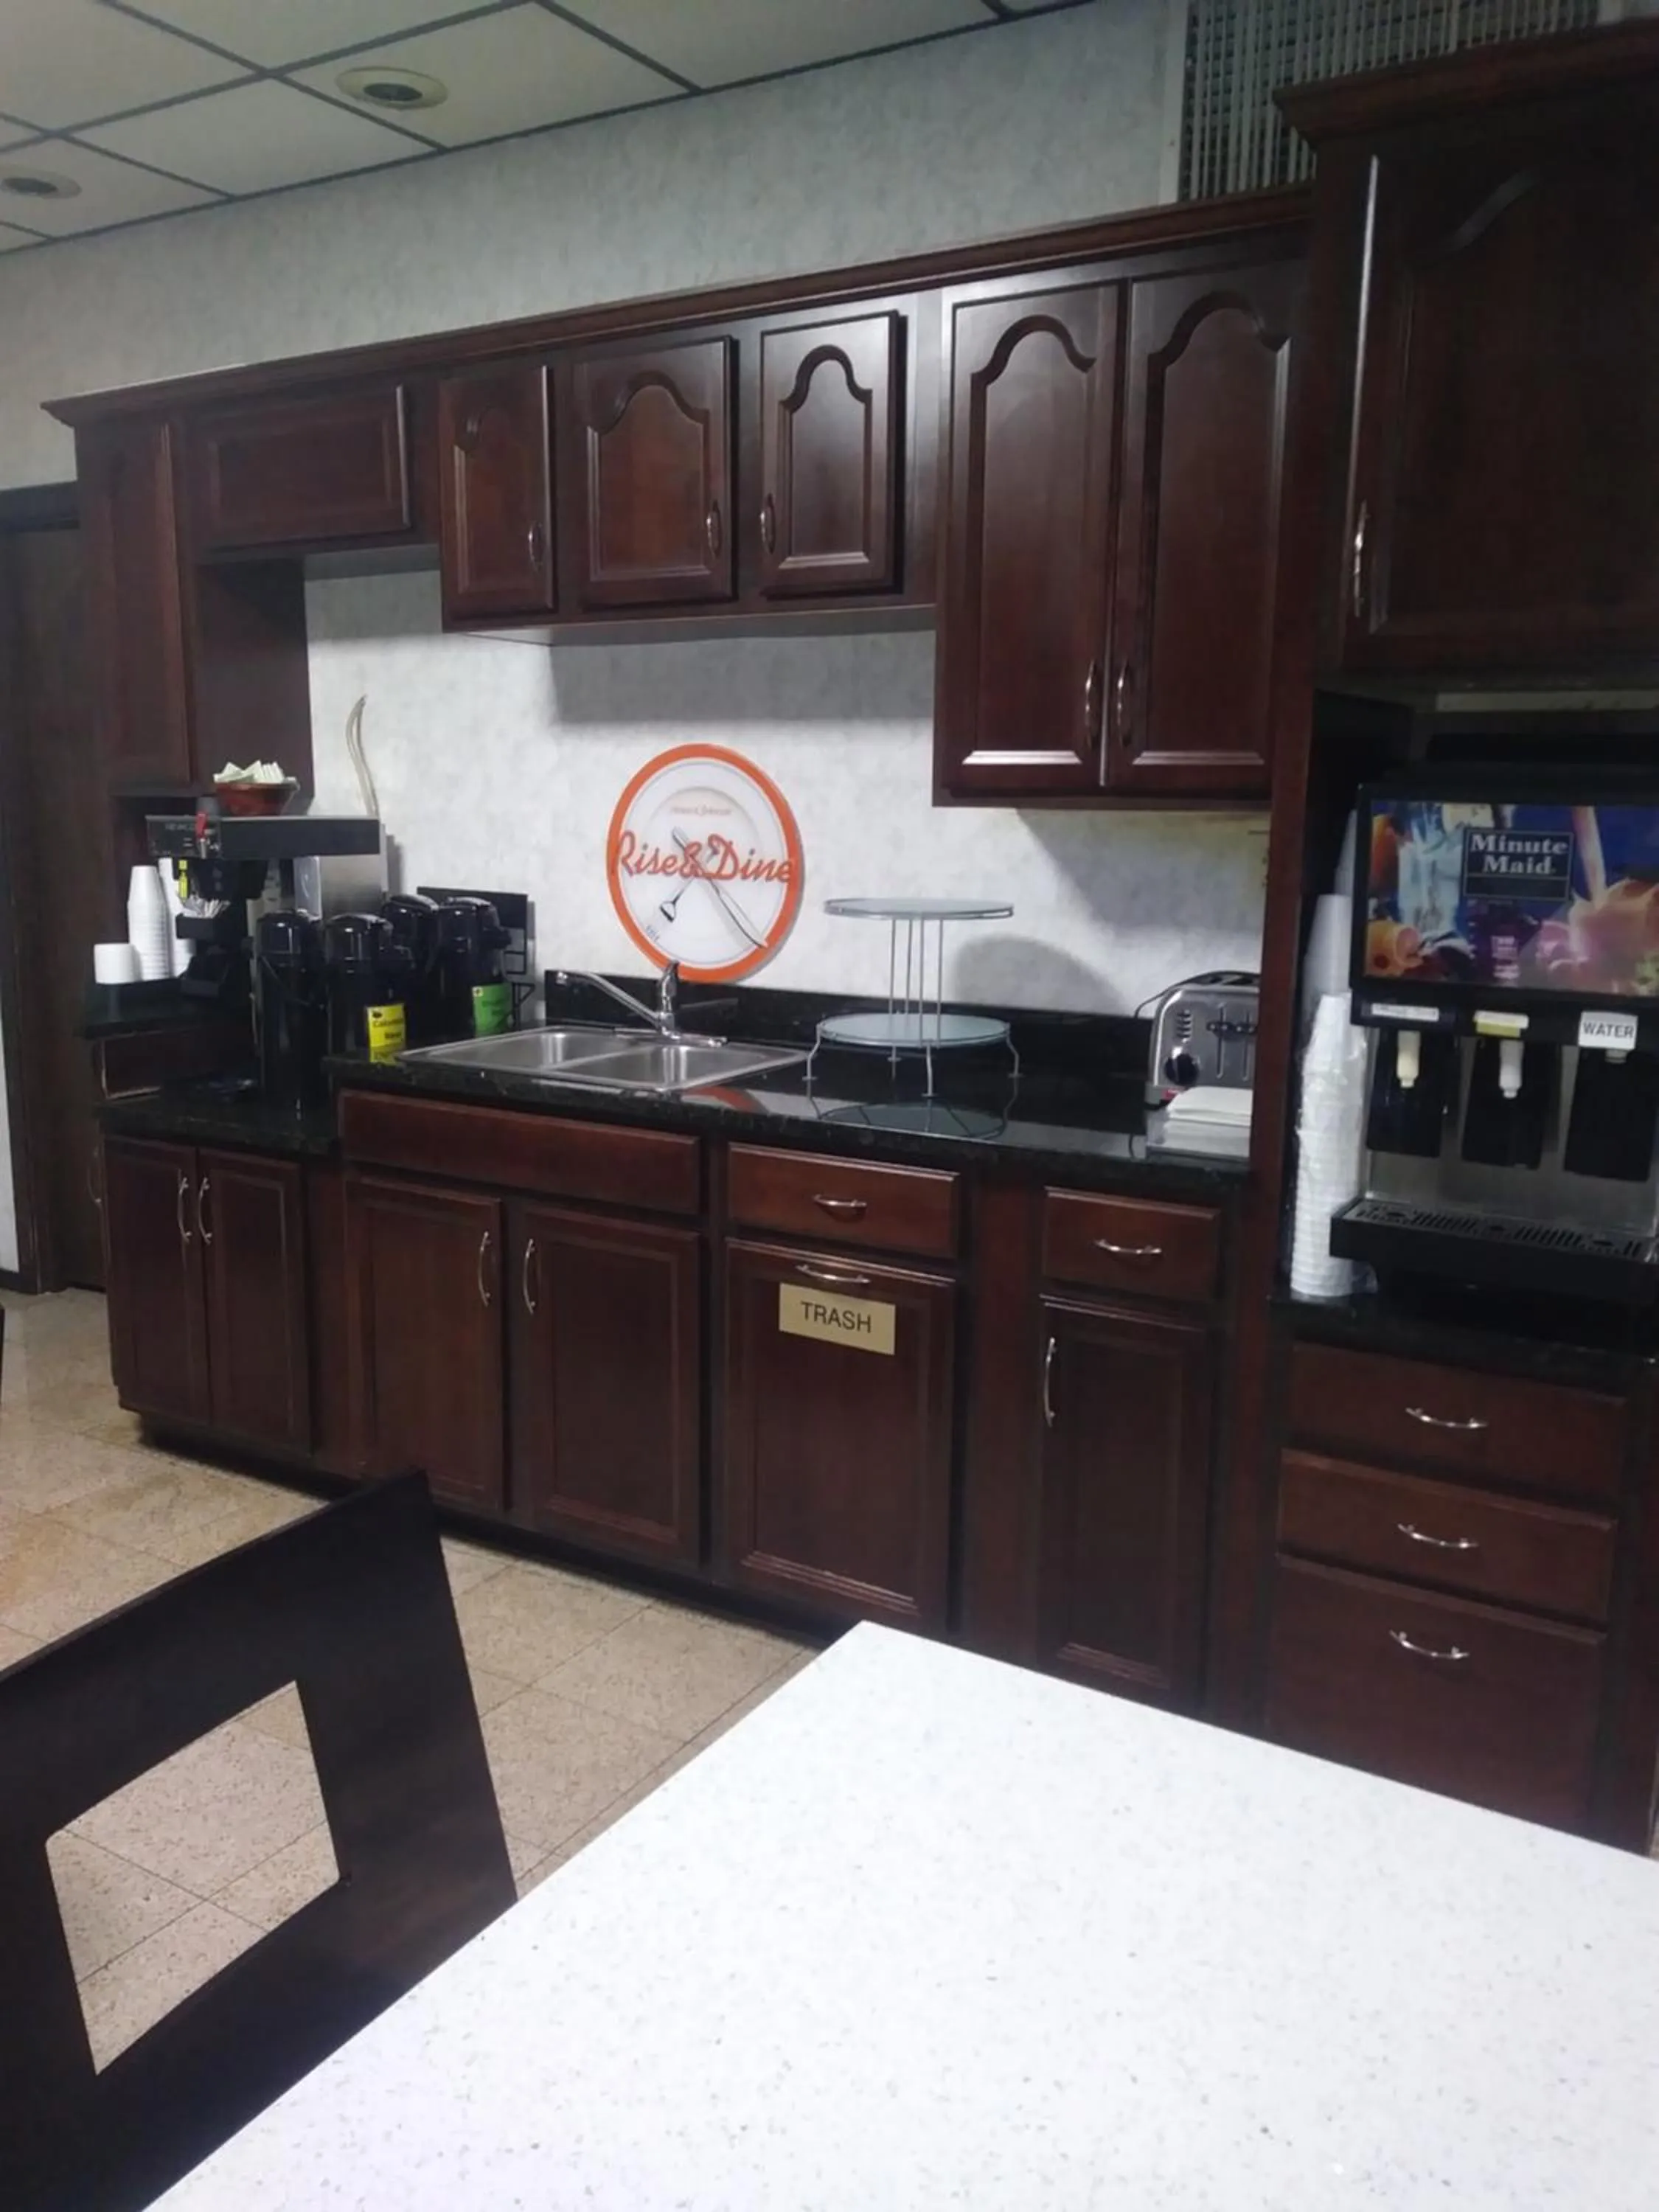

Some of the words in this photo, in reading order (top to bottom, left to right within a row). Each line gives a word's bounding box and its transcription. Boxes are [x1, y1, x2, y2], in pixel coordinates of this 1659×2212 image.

[1470, 833, 1568, 855] Minute
[1483, 855, 1552, 874] Maid
[1583, 1022, 1634, 1038] WATER
[800, 1300, 872, 1333] TRASH
